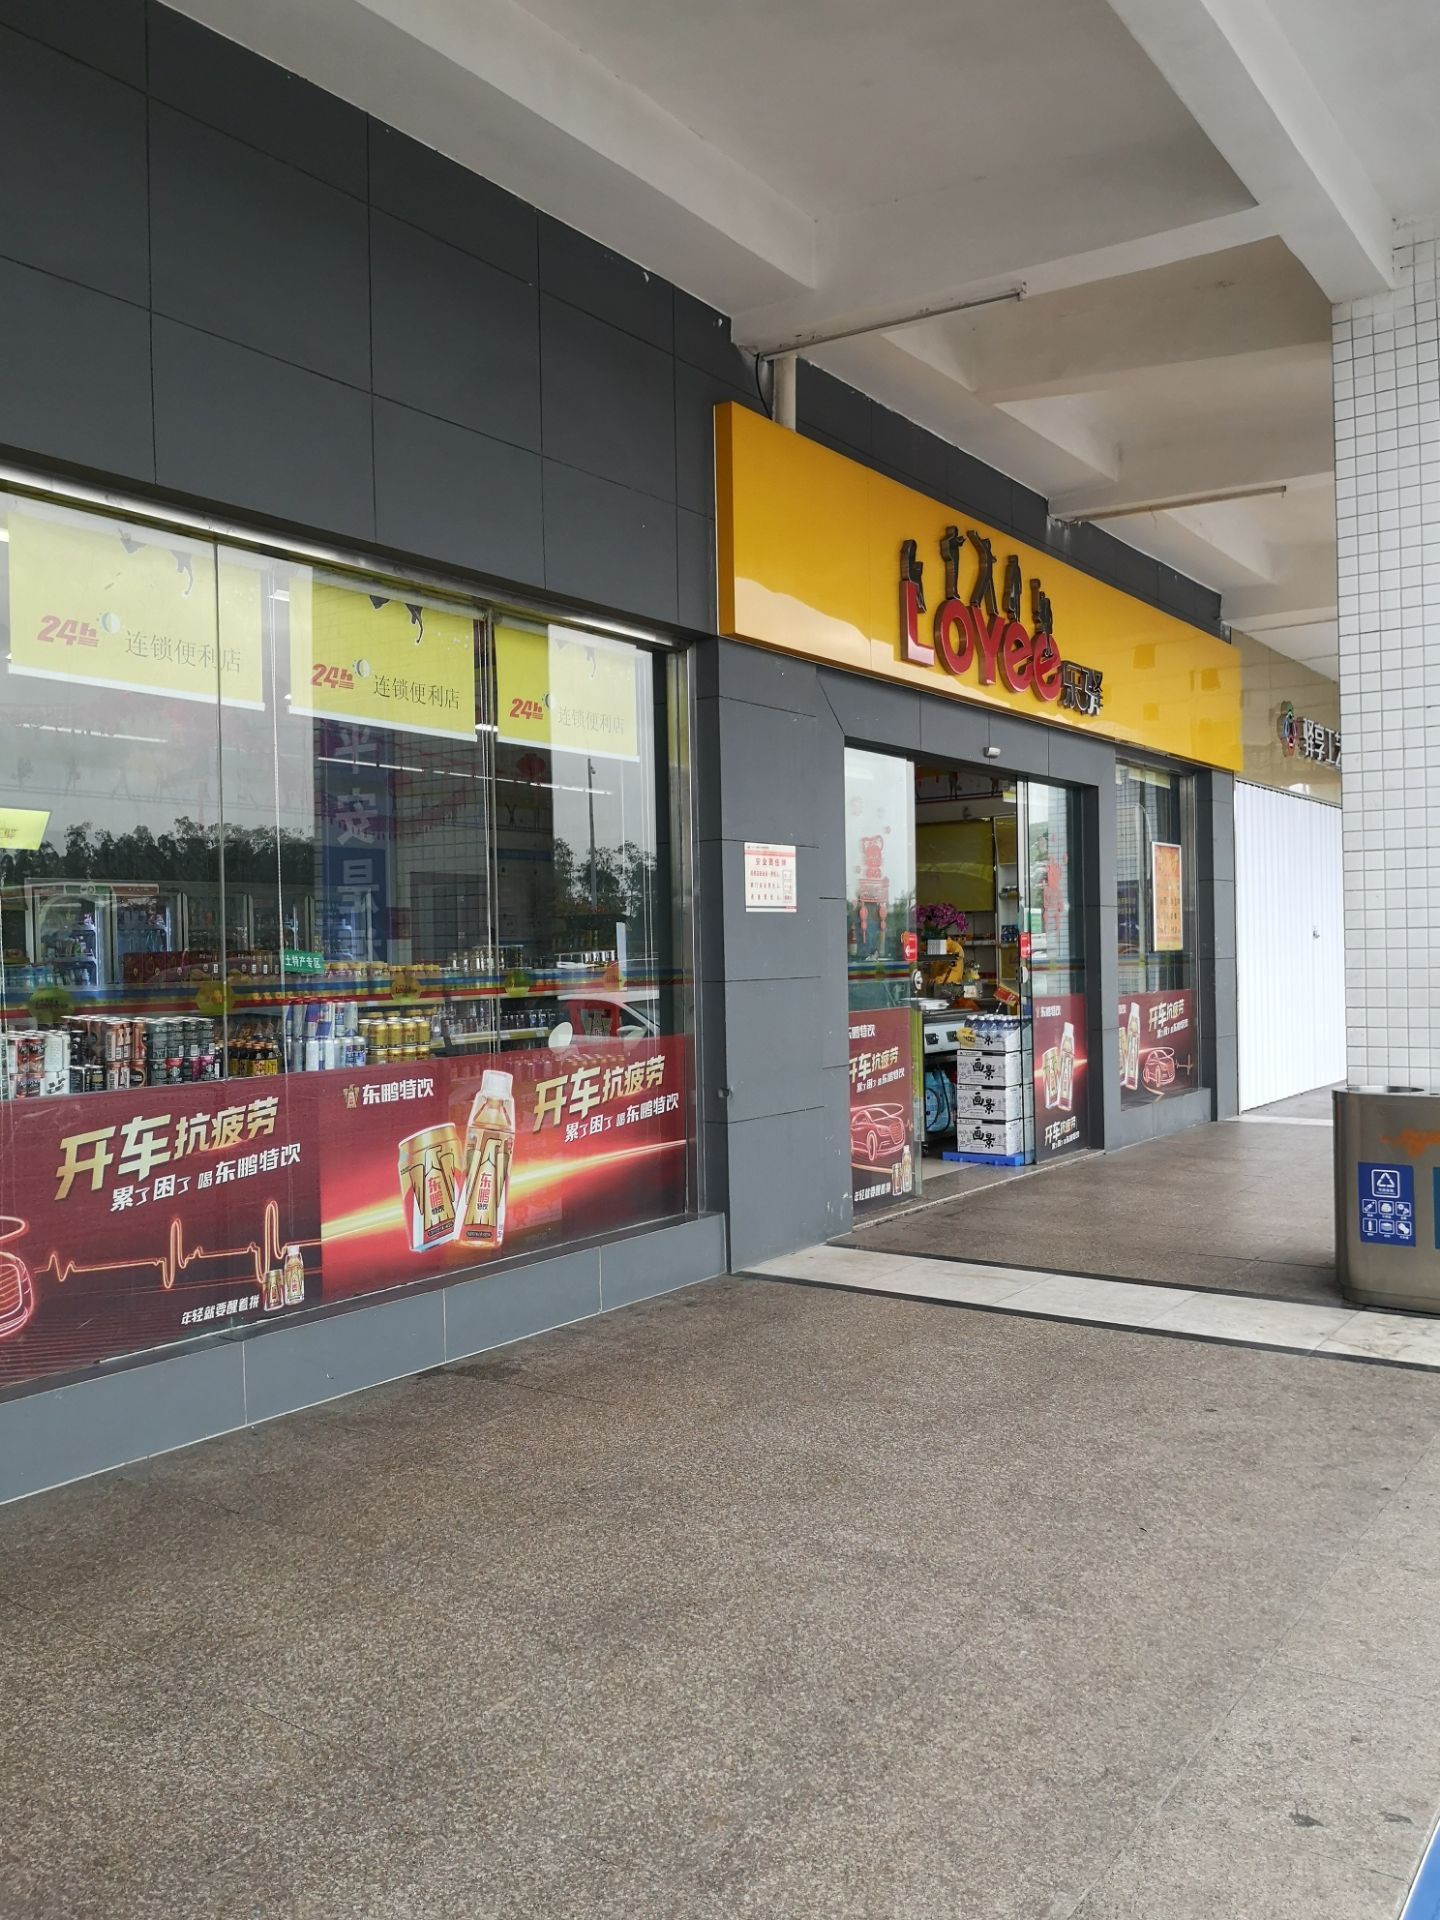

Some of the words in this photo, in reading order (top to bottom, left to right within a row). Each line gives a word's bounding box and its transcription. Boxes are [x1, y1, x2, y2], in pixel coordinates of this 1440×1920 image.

[37, 615, 99, 648] 24h
[124, 630, 242, 674] 连锁便利店
[310, 663, 354, 690] 24h
[373, 674, 461, 711] 连锁便利店
[510, 698, 544, 720] 24h
[558, 705, 625, 735] 连锁便利店
[285, 953, 321, 969] 土特产专区
[362, 1078, 434, 1105] 东鹏特饮
[532, 1055, 666, 1134] 开车抗疲劳
[54, 1096, 279, 1200] 开车抗疲劳
[181, 1295, 260, 1325] 年轻就要醒着拼
